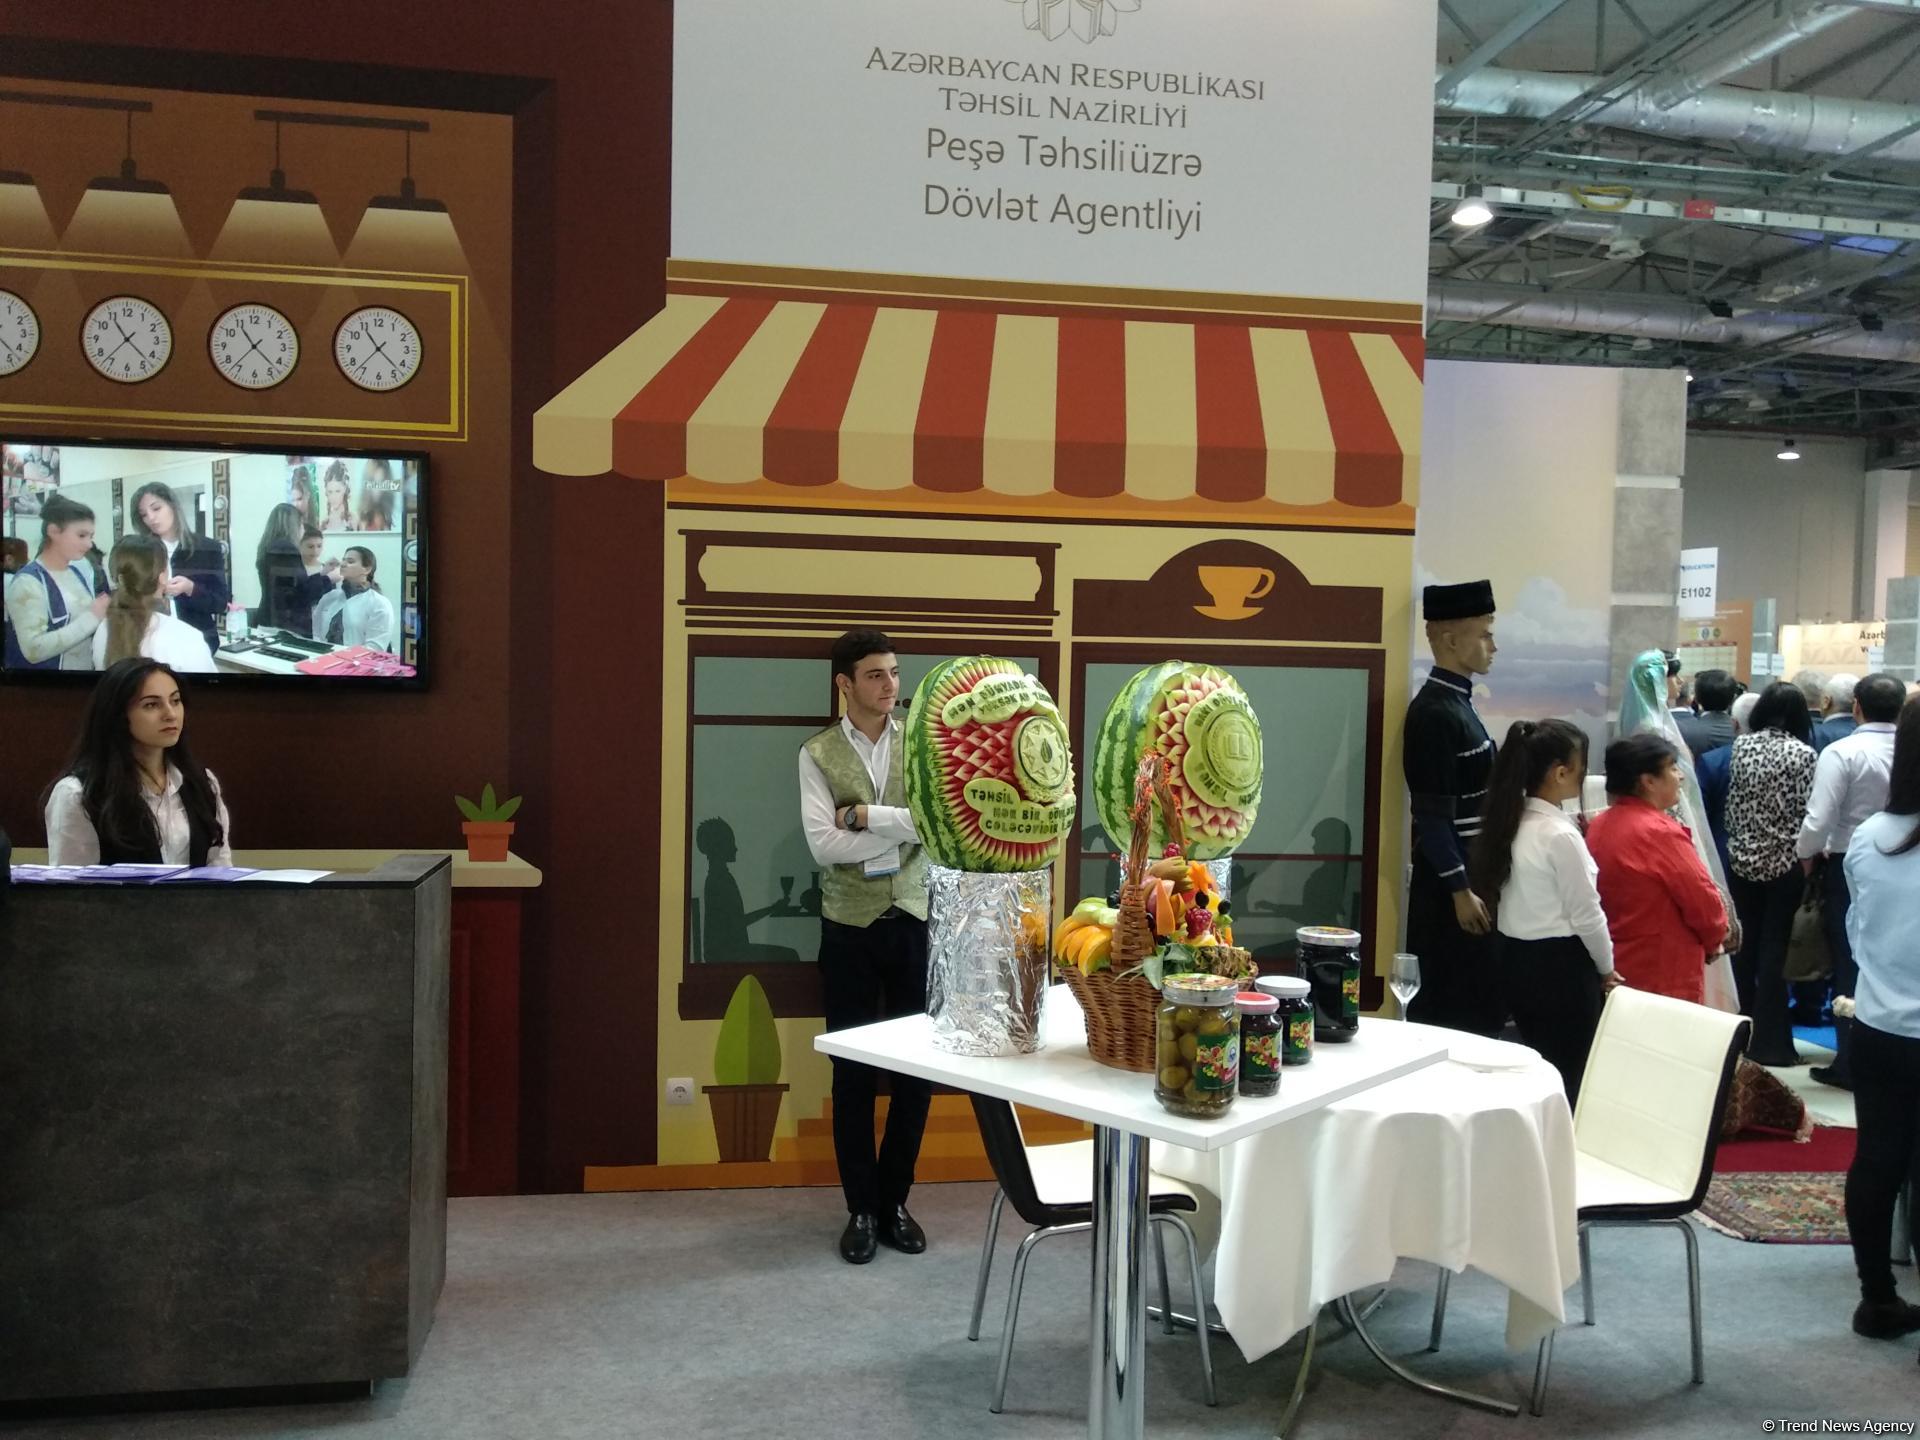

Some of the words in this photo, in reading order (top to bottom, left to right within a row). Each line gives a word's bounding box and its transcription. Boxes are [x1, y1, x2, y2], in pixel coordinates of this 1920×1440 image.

[865, 46, 1061, 84] AZƏRBAYCAN
[1070, 62, 1264, 101] RESPUBLİKASI
[938, 87, 1041, 118] TƏHSİL
[1049, 95, 1188, 129] NAZİRLİYİ
[927, 127, 1005, 171] Peşə
[924, 183, 1039, 222] Dövlət
[1049, 193, 1202, 240] Agentliyi
[122, 307, 133, 318] 12
[17, 315, 23, 325] 2
[249, 315, 260, 325] 12
[373, 318, 384, 327] 12
[98, 321, 108, 330] 10
[150, 323, 157, 332] 2
[21, 329, 27, 338] 3
[225, 328, 236, 338] 10
[276, 330, 283, 339] 2
[350, 331, 360, 340] 10
[400, 333, 407, 342] 2
[93, 334, 99, 343] 9
[153, 336, 160, 345] 3
[16, 344, 22, 352] 4
[221, 342, 227, 351] 9
[280, 343, 286, 352] 3
[346, 344, 352, 353] 9
[403, 345, 410, 354] 3
[97, 347, 104, 357] 8
[149, 350, 155, 359] 4
[6, 354, 13, 362] 5
[225, 355, 232, 364] 8
[275, 357, 282, 365] 4
[350, 357, 356, 366] 8
[124, 363, 130, 372] 6
[140, 360, 146, 369] 5
[400, 359, 406, 367] 4
[251, 369, 258, 378] 6
[267, 367, 273, 376] 5
[375, 371, 382, 380] 6
[391, 369, 397, 378] 5
[1681, 587, 1711, 599] E1102
